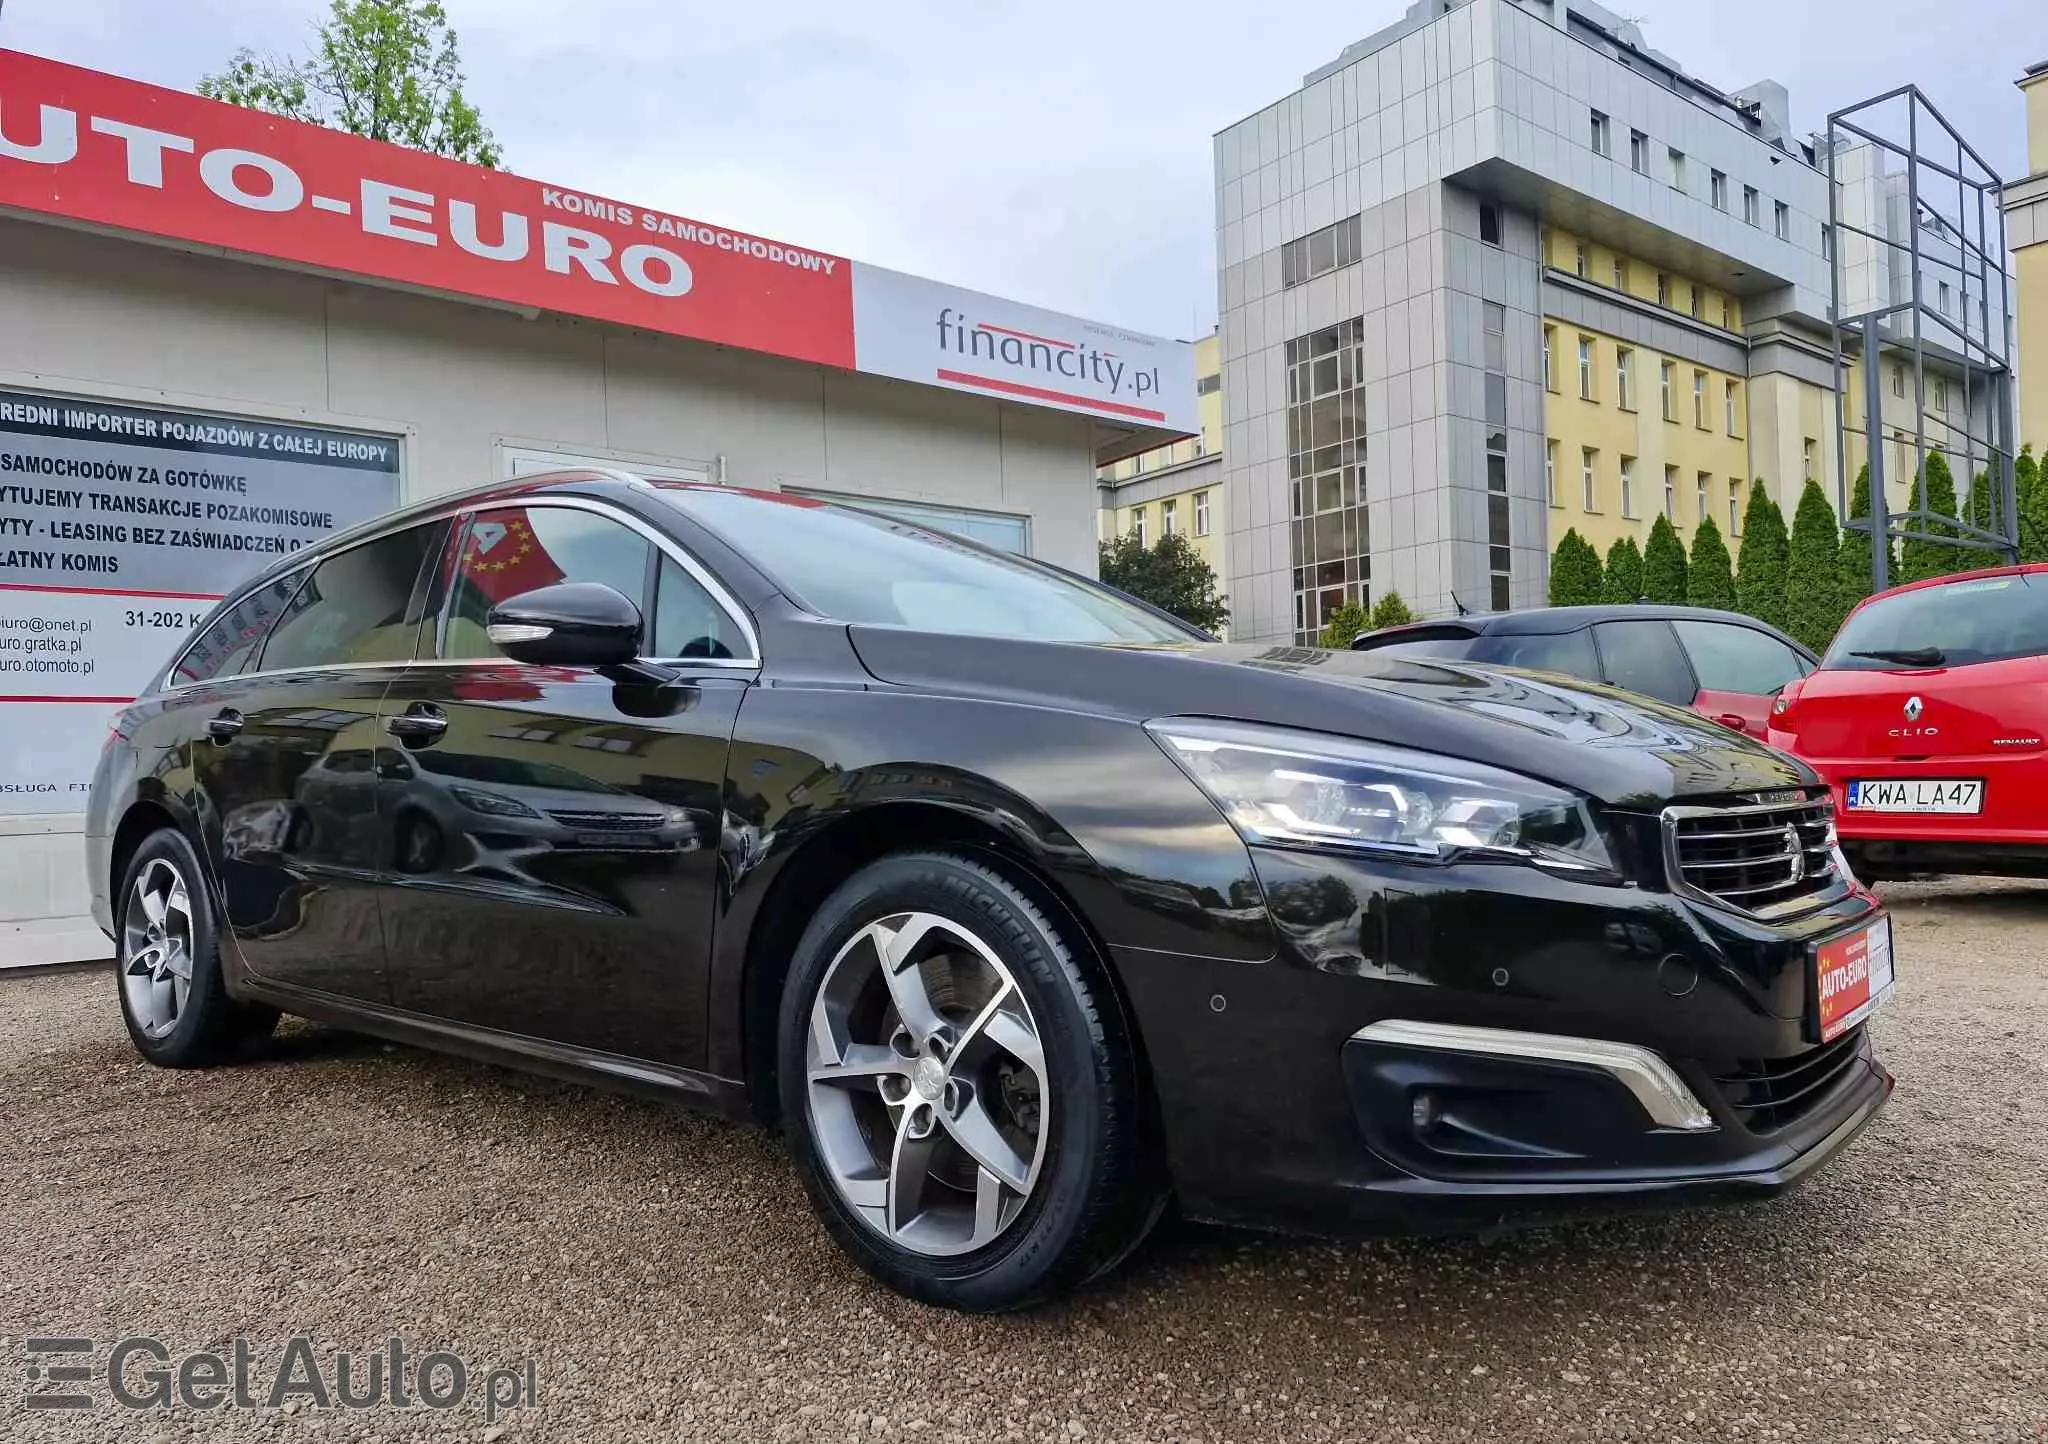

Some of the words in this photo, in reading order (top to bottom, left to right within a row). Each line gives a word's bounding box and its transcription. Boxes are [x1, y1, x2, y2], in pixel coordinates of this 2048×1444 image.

[542, 187, 634, 227] KOMIS
[641, 212, 836, 276] SAMOCHODOWY
[936, 307, 1160, 399] financity.pl
[64, 408, 159, 438] IMPORTER
[162, 420, 254, 448] POJAZDÓW
[258, 432, 270, 450] Z
[273, 434, 323, 456] CAŁEJ
[327, 439, 388, 463] EUROPY
[0, 452, 133, 482] SAMOCHODÓW
[137, 466, 160, 485] ZA
[165, 468, 247, 497] GOTÓWKĘ
[88, 492, 203, 519] TRANSAKCJE
[206, 501, 334, 529] POZAKOMISOWE
[50, 520, 128, 543] LEASING
[132, 526, 166, 546] BEZ
[169, 527, 286, 554] ZAŚWIADCZEŃ
[61, 551, 120, 574] KOMIS
[125, 610, 184, 629] 31-202
[1888, 727, 1939, 738] CLIO
[1862, 783, 1907, 805] KWA
[1916, 783, 1977, 806] LA47
[1822, 954, 1868, 1000] AUTO-EURO
